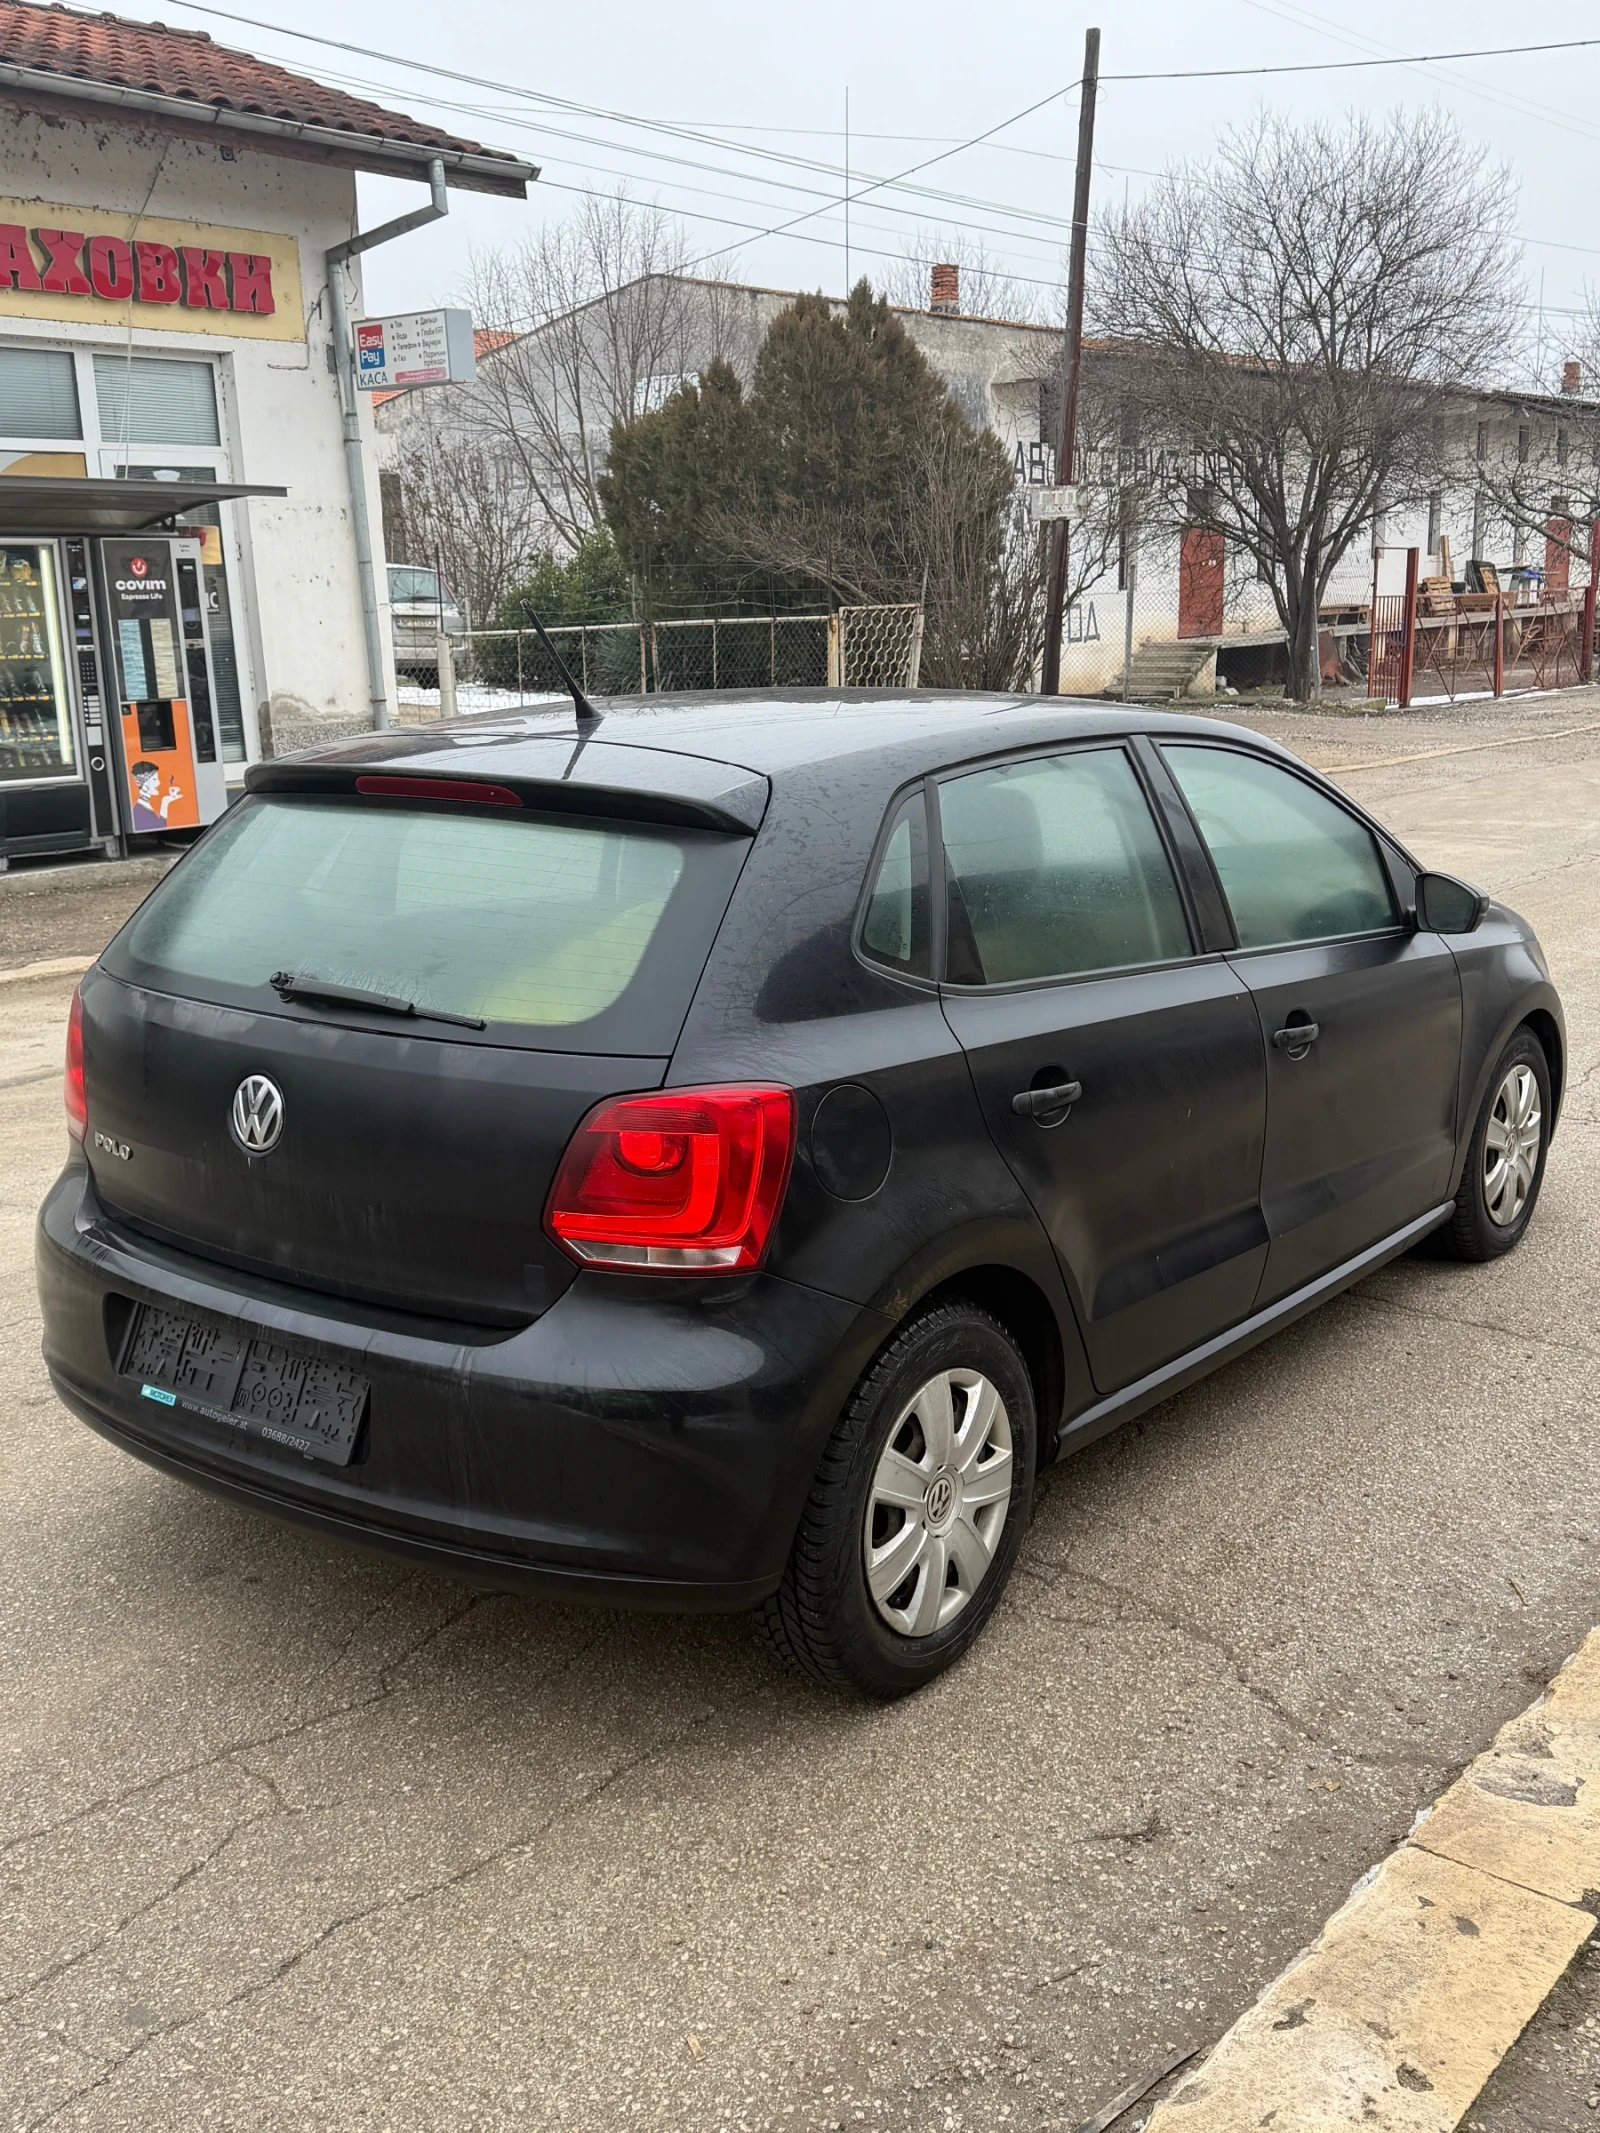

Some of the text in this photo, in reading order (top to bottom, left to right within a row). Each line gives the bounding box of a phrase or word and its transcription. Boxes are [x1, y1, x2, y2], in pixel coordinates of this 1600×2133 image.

[0, 223, 275, 314] АХОВКИ
[359, 334, 383, 349] Easy
[397, 342, 417, 351] Телефон
[361, 349, 380, 366] Pay
[359, 371, 388, 386] КАСА
[1038, 490, 1077, 505] ГТП
[115, 580, 167, 591] covim
[121, 592, 163, 601] Espresso Life
[94, 1131, 132, 1161] POLO
[181, 1400, 311, 1451] www.autogeier.at 03688/2427
